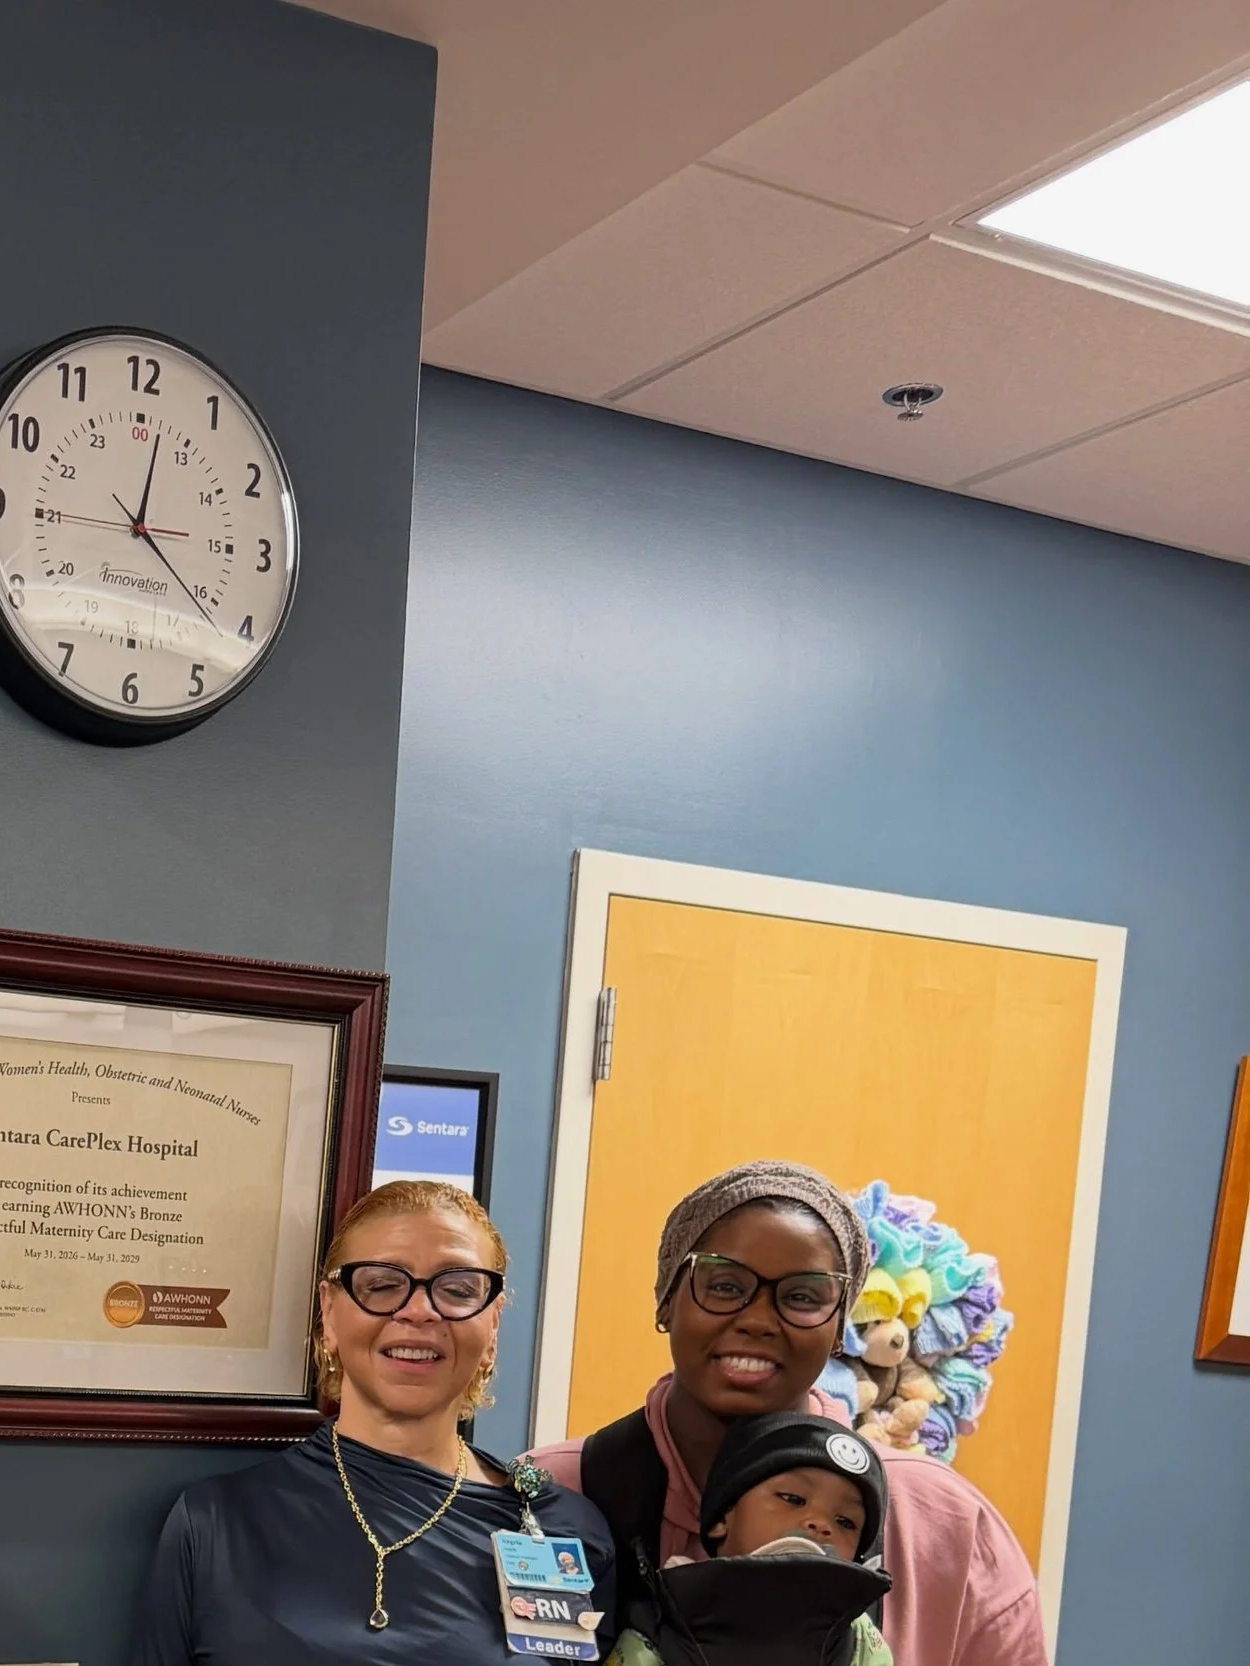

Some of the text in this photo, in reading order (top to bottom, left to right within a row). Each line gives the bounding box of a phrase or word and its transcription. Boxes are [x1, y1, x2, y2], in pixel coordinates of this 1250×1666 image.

[57, 363, 86, 402] 11
[127, 356, 160, 396] 12
[207, 395, 219, 430] 1
[8, 413, 40, 452] 10
[90, 434, 106, 449] 23
[132, 427, 148, 442] 00
[174, 452, 188, 466] 13
[60, 465, 76, 480] 22
[245, 463, 261, 498] 2
[199, 492, 212, 506] 14
[47, 509, 62, 524] 21
[208, 540, 221, 553] 15
[256, 539, 271, 573] 3
[58, 562, 74, 576] 20
[101, 567, 168, 592] Innovation
[8, 574, 25, 610] 8
[193, 585, 207, 599] 16
[84, 600, 98, 613] 19
[125, 621, 138, 634] 18
[238, 615, 255, 644] 4
[57, 642, 75, 676] 7
[121, 672, 139, 705] 6
[188, 664, 205, 697] 5
[48, 1061, 90, 1077] Health,
[95, 1064, 148, 1084] Obstetric
[149, 1077, 174, 1091] and
[174, 1080, 227, 1107] Neonatal
[226, 1099, 261, 1126] Nurses
[71, 1091, 111, 1105] Presents
[417, 1121, 470, 1136] Sentara
[46, 1128, 122, 1152] CarePlex
[127, 1135, 198, 1160] Hospital
[0, 1179, 72, 1195] recognition
[76, 1180, 91, 1195] of
[93, 1183, 107, 1196] its
[111, 1184, 188, 1201] achievement
[2, 1200, 51, 1218] earning
[53, 1201, 136, 1220] AWHONN's
[140, 1206, 183, 1222] Bronze
[30, 1221, 94, 1242] Maternity
[98, 1225, 126, 1240] Care
[130, 1228, 204, 1247] Designation
[24, 1248, 41, 1259] May
[44, 1250, 57, 1260] 31,
[59, 1251, 78, 1260] 2026
[87, 1252, 104, 1264] May
[121, 1255, 140, 1264] 2029
[164, 1293, 211, 1304] AWHONN
[535, 1599, 571, 1620] RN
[525, 1637, 581, 1657] Leader
